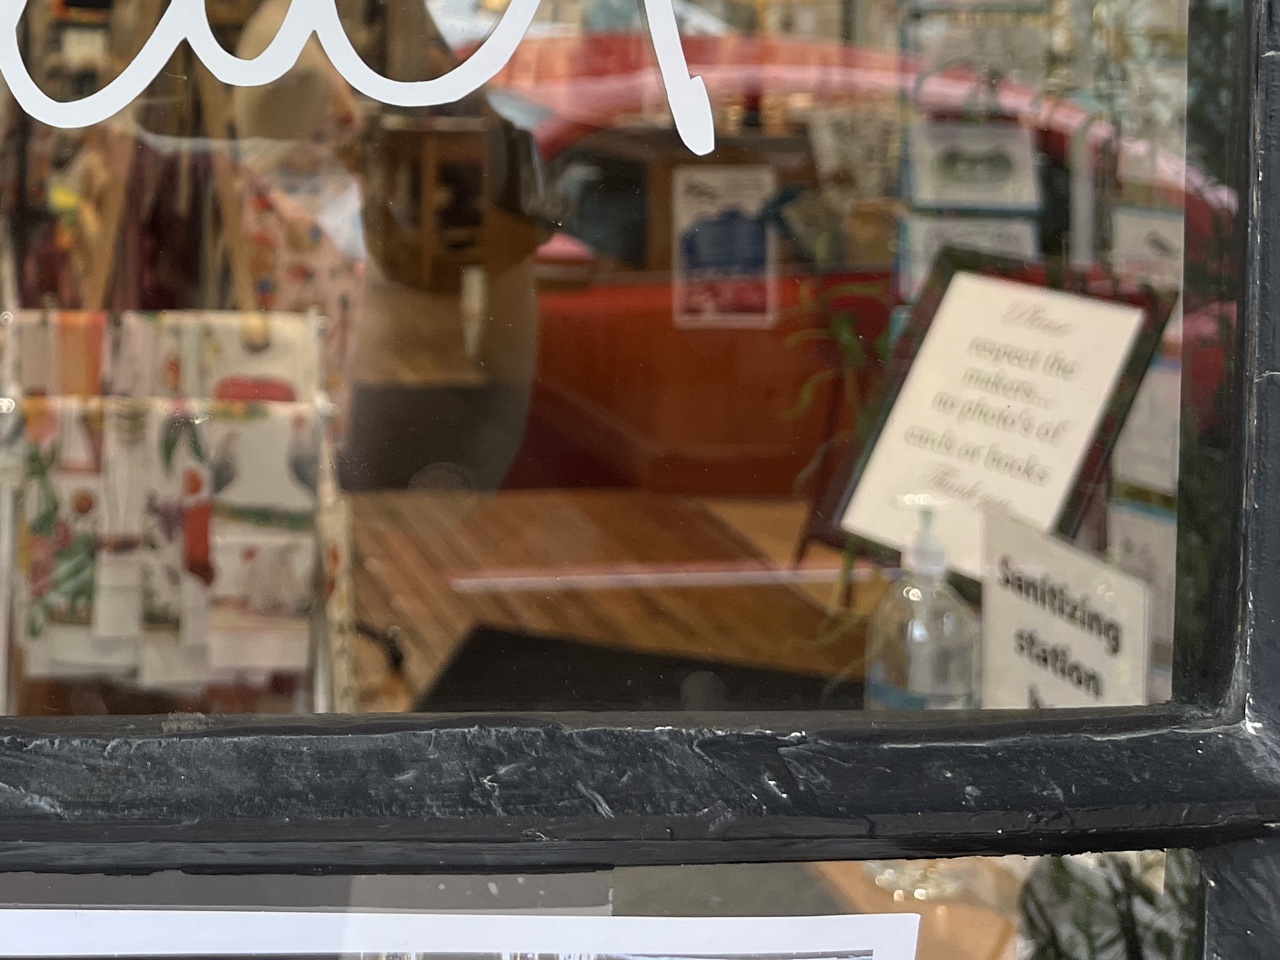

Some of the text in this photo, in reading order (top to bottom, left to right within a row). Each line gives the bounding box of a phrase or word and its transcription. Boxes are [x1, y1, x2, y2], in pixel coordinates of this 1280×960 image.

[968, 336, 1081, 381] respect the
[931, 391, 961, 415] no
[1036, 419, 1071, 447] of
[956, 441, 985, 465] or
[983, 442, 1052, 486] books
[997, 554, 1122, 657] Sanitizing
[1015, 627, 1103, 701] station
